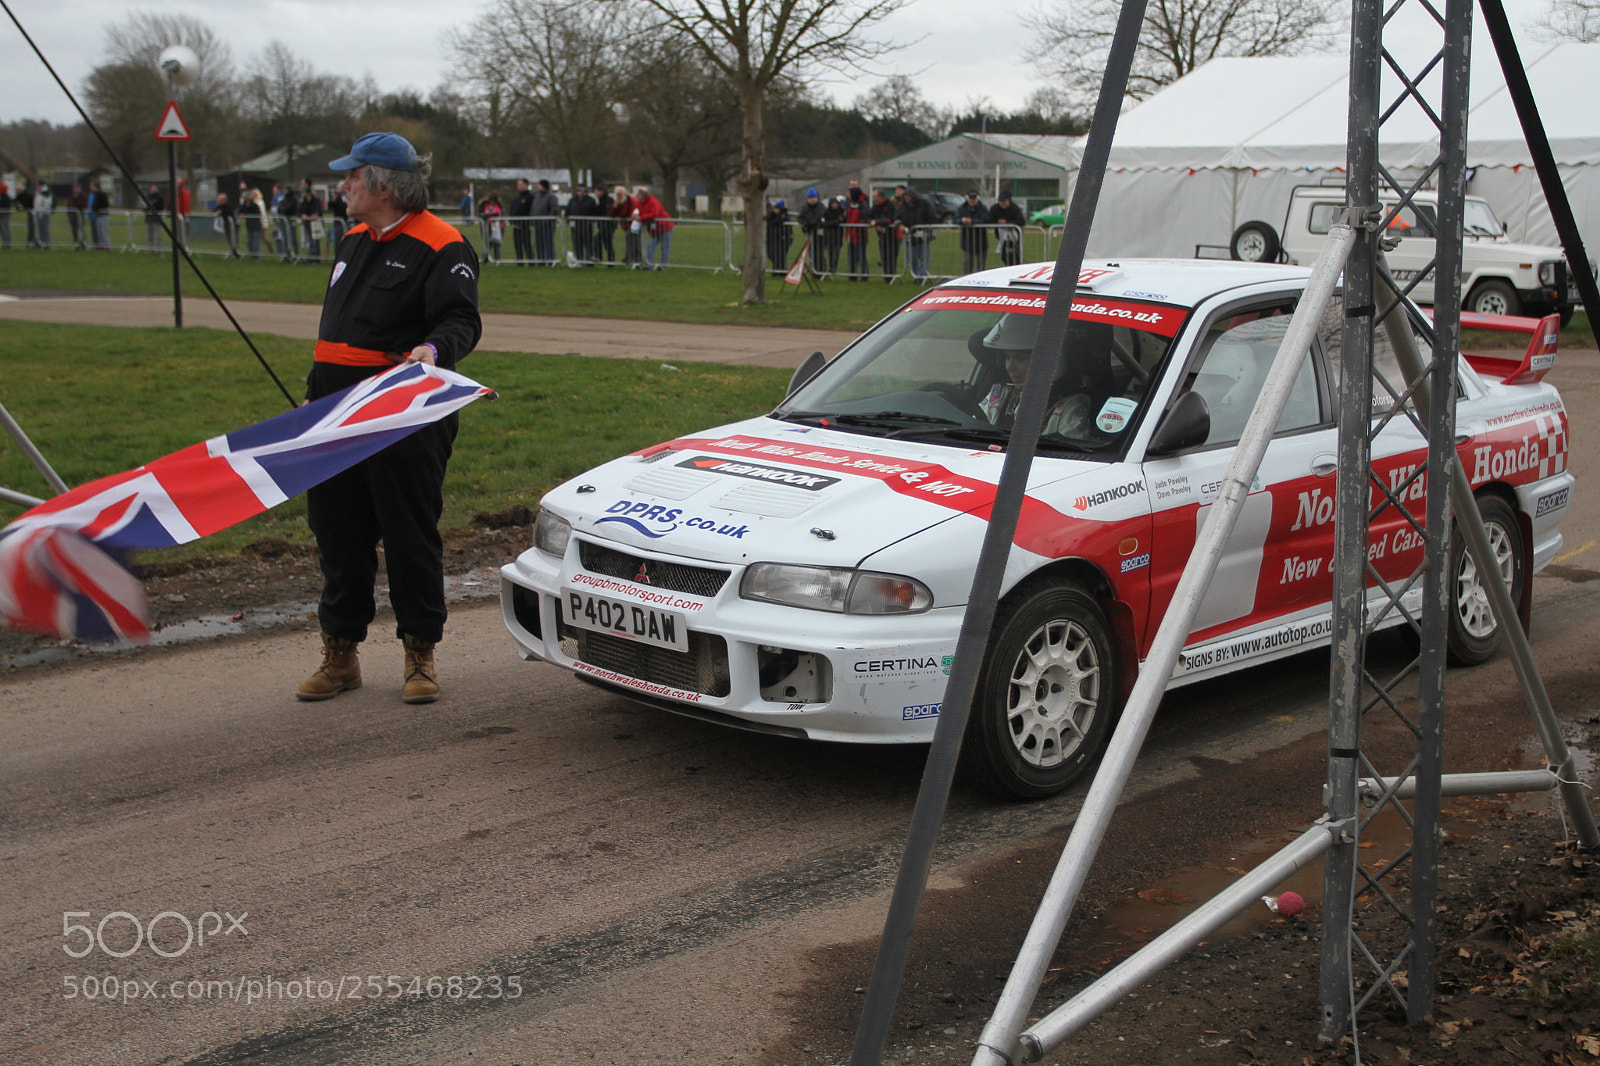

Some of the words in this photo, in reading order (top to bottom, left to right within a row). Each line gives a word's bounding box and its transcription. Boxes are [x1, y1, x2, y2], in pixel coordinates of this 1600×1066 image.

[923, 294, 1163, 325] www.northwaleonda.co.uk
[1471, 435, 1539, 485] Honda
[900, 471, 929, 484] &
[915, 480, 975, 497] MOT
[605, 500, 750, 539] DPRS.co.uk
[1121, 553, 1150, 573] sparco
[1280, 556, 1323, 585] New
[1392, 528, 1425, 554] Cars
[571, 571, 703, 612] groupbmotorsport.com
[569, 592, 627, 632] P402
[631, 606, 676, 644] DAW
[1186, 652, 1213, 670] SIGNS
[1215, 650, 1230, 660] BY:
[1230, 618, 1332, 656] www.autotop.co.u
[572, 661, 702, 702] www.northwaleshonda.co.uk
[854, 657, 938, 673] CERTINA
[904, 704, 942, 720] sparc
